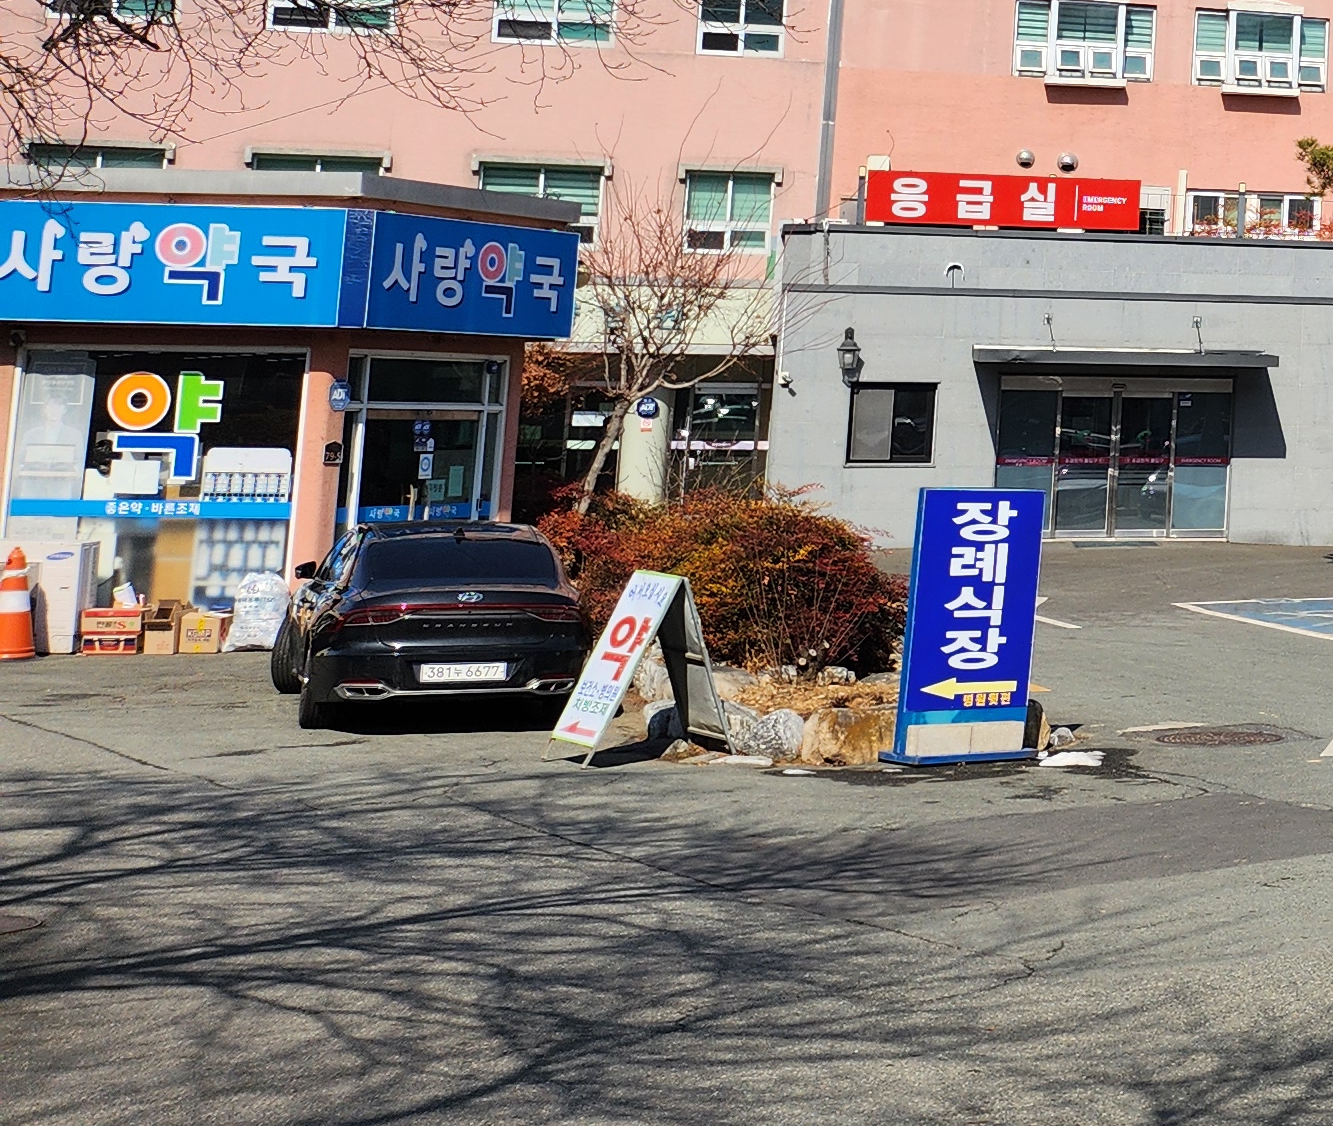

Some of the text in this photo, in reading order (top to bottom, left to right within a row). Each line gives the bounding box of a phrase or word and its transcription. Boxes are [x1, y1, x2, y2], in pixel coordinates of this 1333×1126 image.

[890, 177, 1056, 222] 응급실
[1082, 195, 1127, 205] EMERGENCY
[1082, 204, 1104, 212] ROOM
[3, 220, 318, 305] 사랑약국
[382, 232, 564, 317] 사랑약국
[107, 370, 224, 482] 약
[940, 500, 1018, 670] 장례식장
[601, 615, 652, 682] 약
[572, 697, 611, 716] 처방조제
